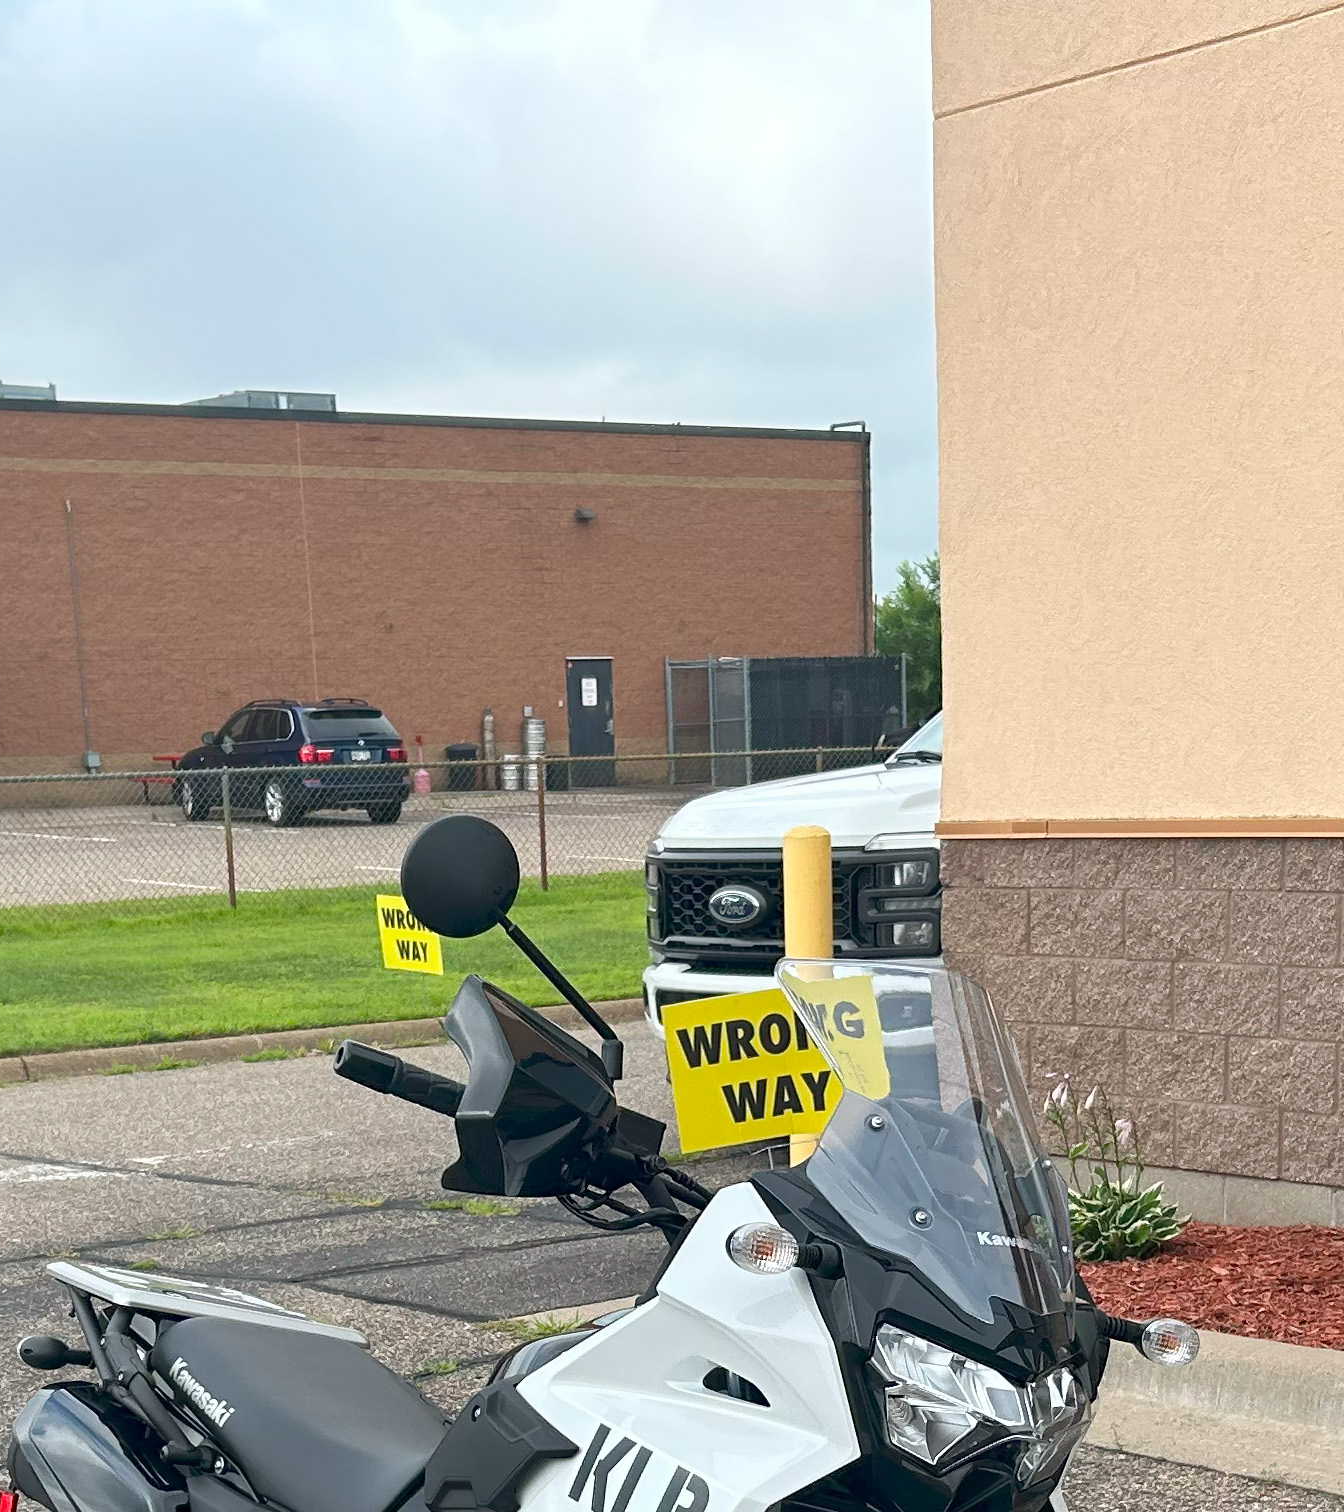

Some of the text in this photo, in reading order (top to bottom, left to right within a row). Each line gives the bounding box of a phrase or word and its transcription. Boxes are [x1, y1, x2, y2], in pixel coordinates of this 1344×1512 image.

[719, 896, 746, 915] Ford
[381, 908, 434, 932] WRO
[396, 939, 427, 963] WAY
[721, 1070, 831, 1123] WAY
[169, 1357, 235, 1427] Kawasaki
